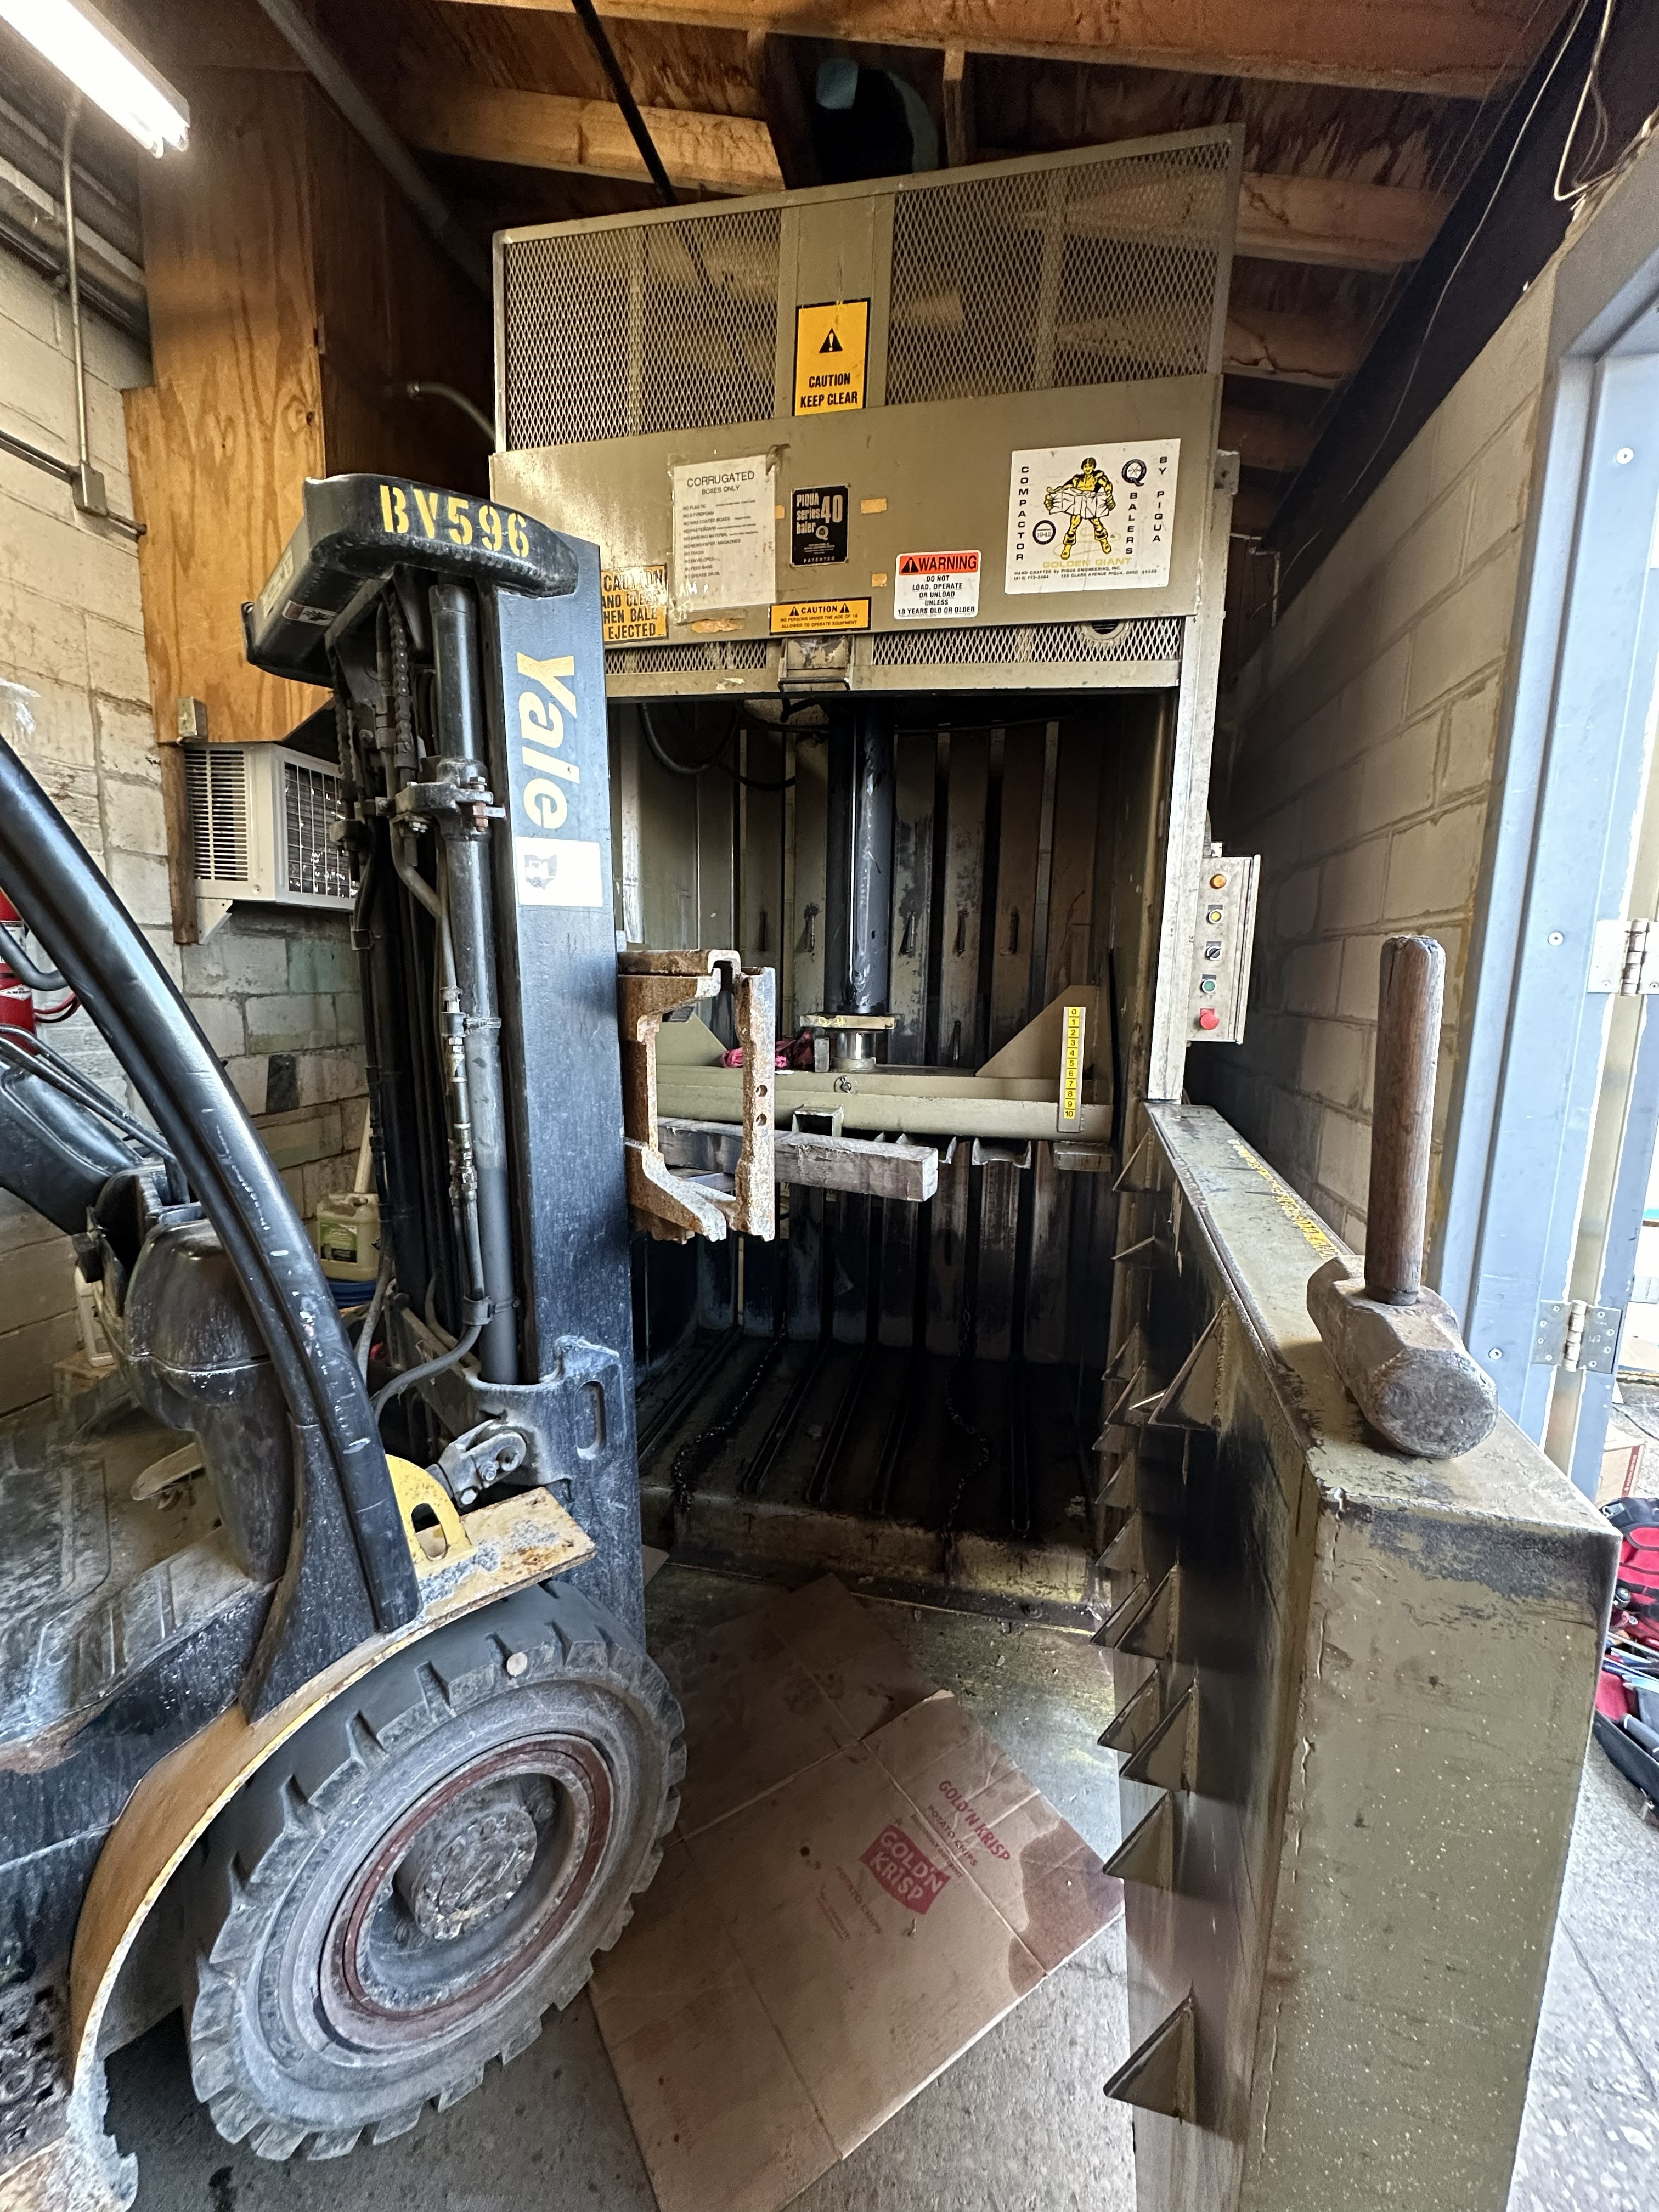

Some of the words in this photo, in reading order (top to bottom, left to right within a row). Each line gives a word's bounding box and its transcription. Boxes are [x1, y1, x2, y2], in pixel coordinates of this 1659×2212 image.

[809, 373, 850, 388] CAUTION
[800, 394, 825, 408] KEEP
[827, 391, 857, 405] CLEAR
[1159, 456, 1167, 475] BY
[687, 471, 754, 487] CORRUGATED
[701, 487, 722, 495] BOXES
[797, 493, 819, 507] PIQUA
[797, 507, 820, 521] series
[820, 495, 843, 524] 40
[1015, 466, 1029, 560] COMPACTOR
[1152, 491, 1164, 542] PIQUA
[380, 485, 529, 558] BV596
[797, 521, 816, 534] baler
[1125, 492, 1137, 554] BALERS
[918, 555, 977, 571] WARNING
[1095, 557, 1132, 566] GIANT
[604, 609, 624, 624] HEN
[630, 606, 657, 622] BALE
[801, 605, 837, 614] CAUTION
[608, 623, 656, 640] EJECTED
[517, 652, 580, 830] Yale
[939, 1780, 980, 1826] GOLD'N
[975, 1822, 1011, 1860] KRISP
[927, 1805, 955, 1838] POTATO
[955, 1839, 978, 1866] CHIPS
[880, 1831, 943, 1893] GOLD'N
